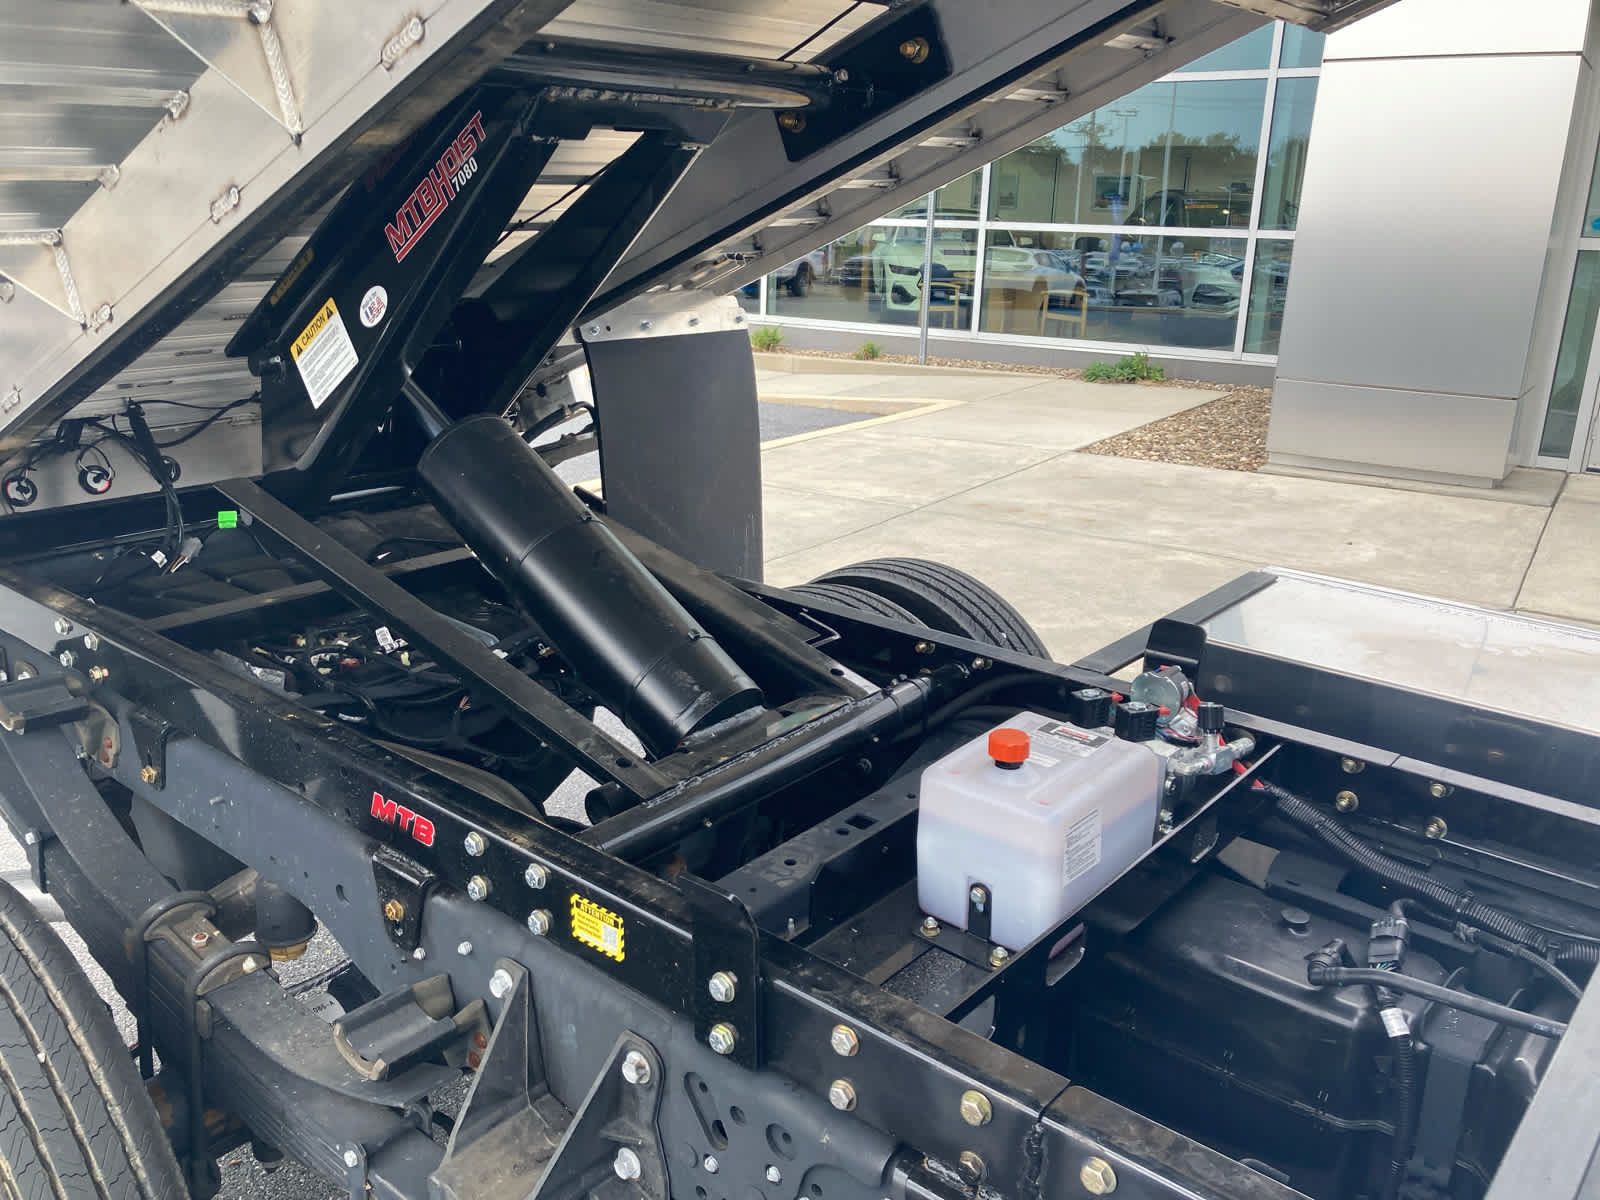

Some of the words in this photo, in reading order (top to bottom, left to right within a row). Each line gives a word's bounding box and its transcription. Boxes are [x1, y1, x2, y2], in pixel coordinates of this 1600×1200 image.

[451, 156, 479, 192] 7080
[301, 313, 327, 346] CAUTION
[371, 792, 436, 847] MTB
